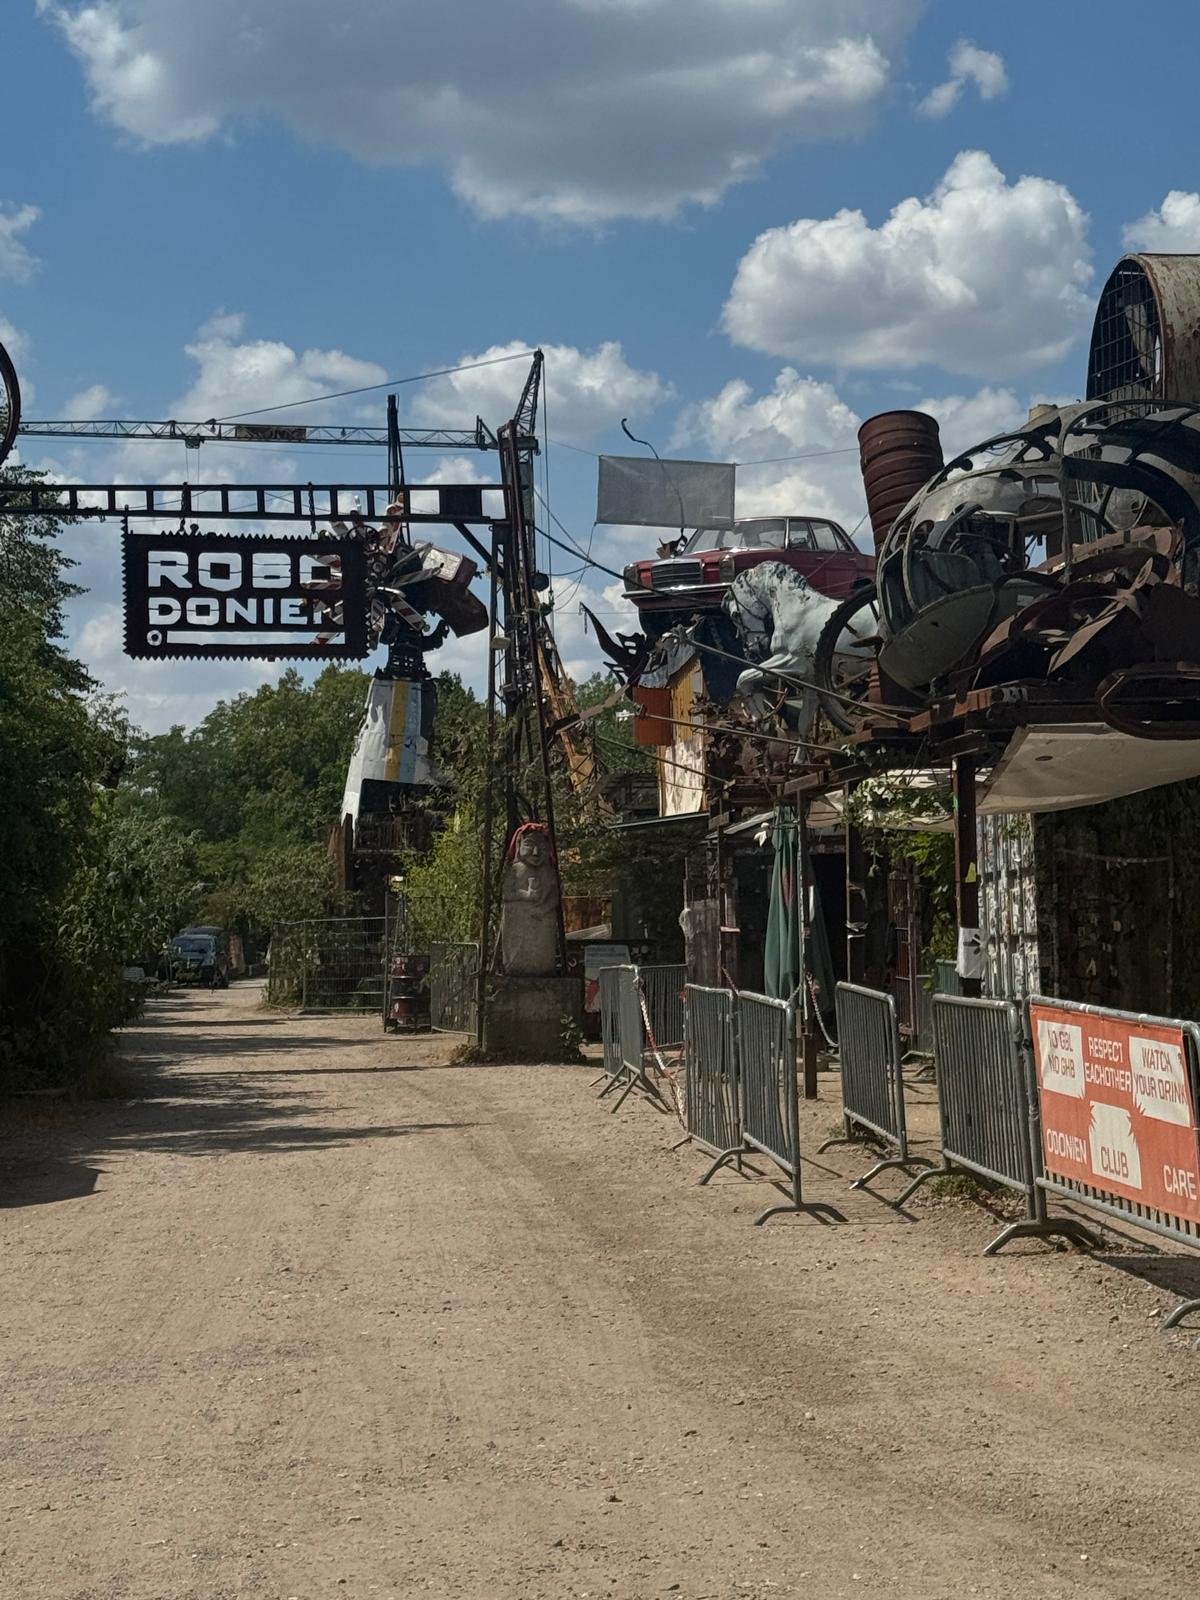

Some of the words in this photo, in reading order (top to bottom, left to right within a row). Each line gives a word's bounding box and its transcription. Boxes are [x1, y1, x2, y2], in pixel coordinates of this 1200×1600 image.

[148, 551, 342, 591] ROBO
[148, 597, 344, 625] DONIEN
[1087, 1037, 1123, 1063] RESPECT
[1142, 1047, 1172, 1073] WATCH
[1061, 1057, 1076, 1079] GHB
[1085, 1063, 1131, 1092] EACHOTHER
[1134, 1072, 1157, 1098] YOUR
[1047, 1128, 1088, 1164] ODONIEN
[1101, 1146, 1129, 1178] CLUB
[1163, 1165, 1197, 1201] CARE
